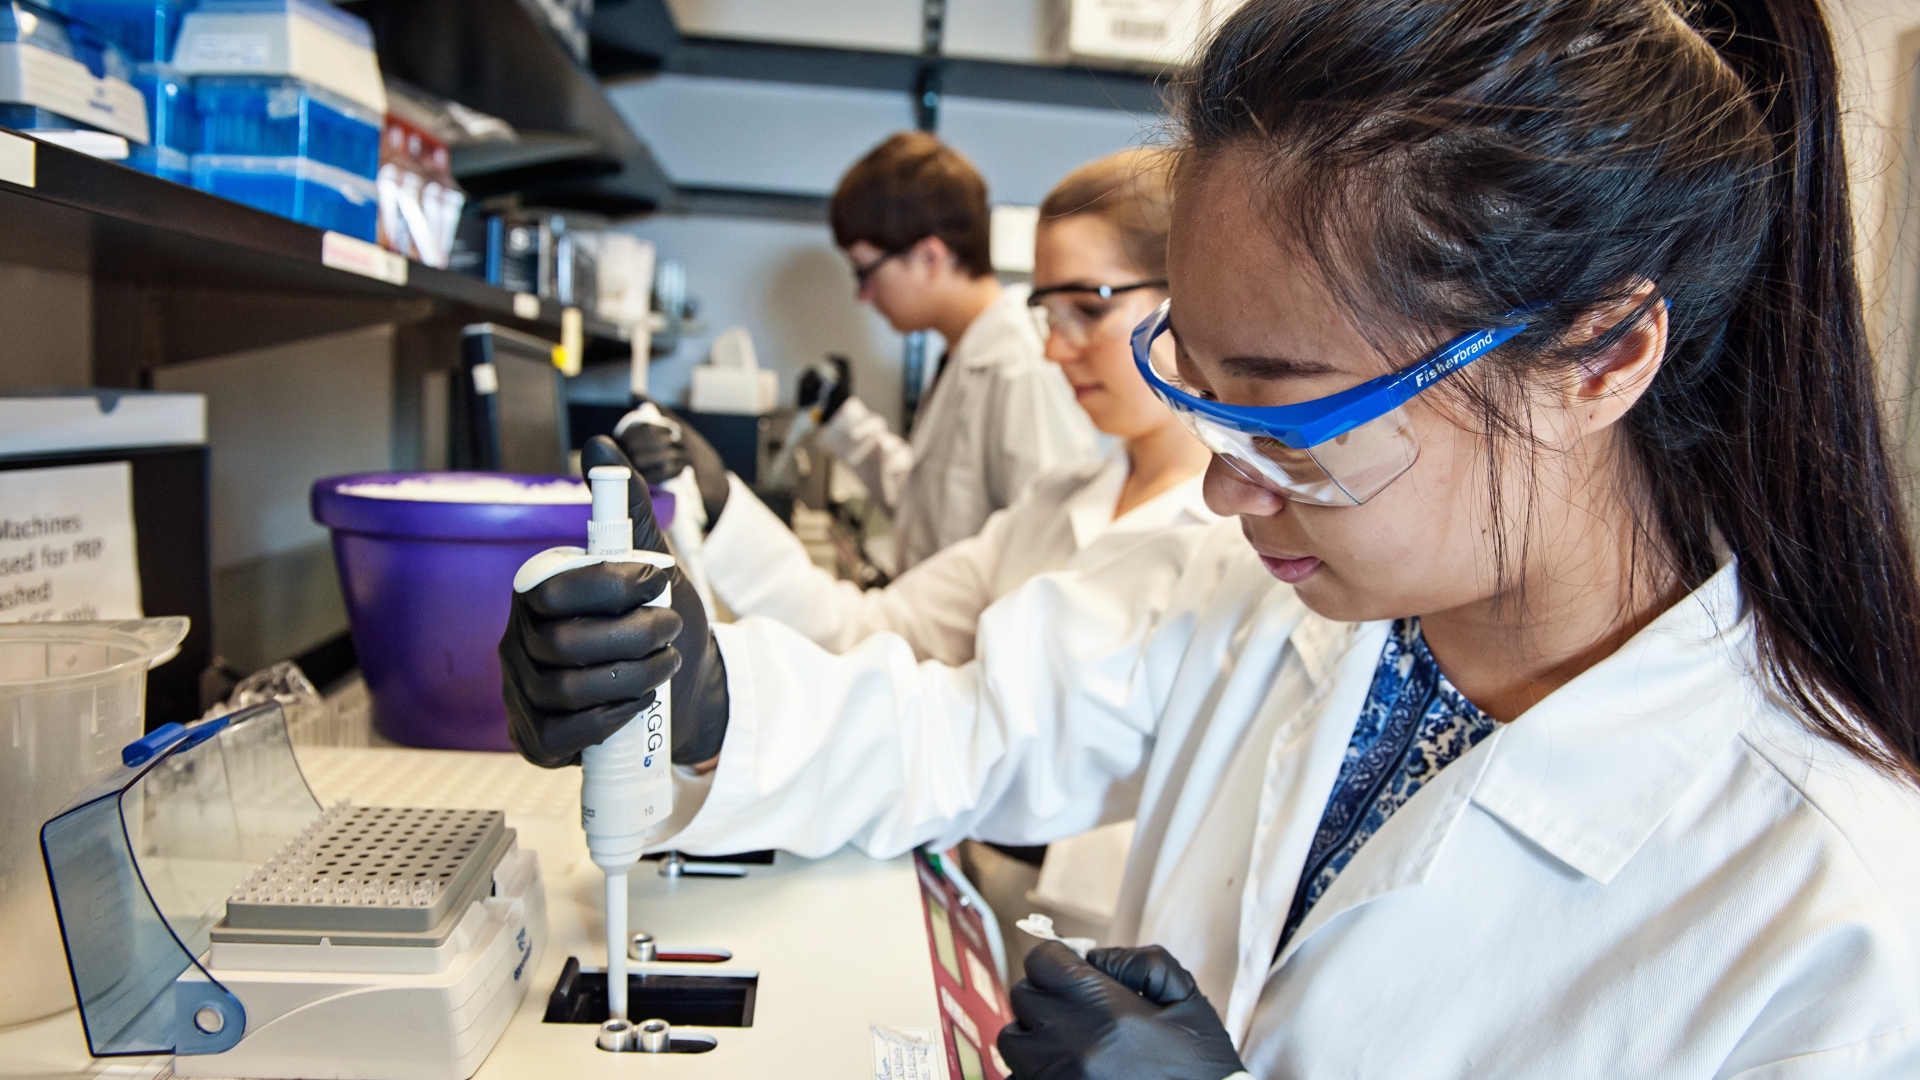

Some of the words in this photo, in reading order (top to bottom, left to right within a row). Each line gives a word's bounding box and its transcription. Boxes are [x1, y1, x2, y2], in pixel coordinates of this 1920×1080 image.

[1416, 332, 1493, 387] Fisherbrand
[41, 545, 68, 568] for
[0, 580, 51, 610] shed
[646, 700, 663, 753] AGG
[644, 805, 654, 817] 10
